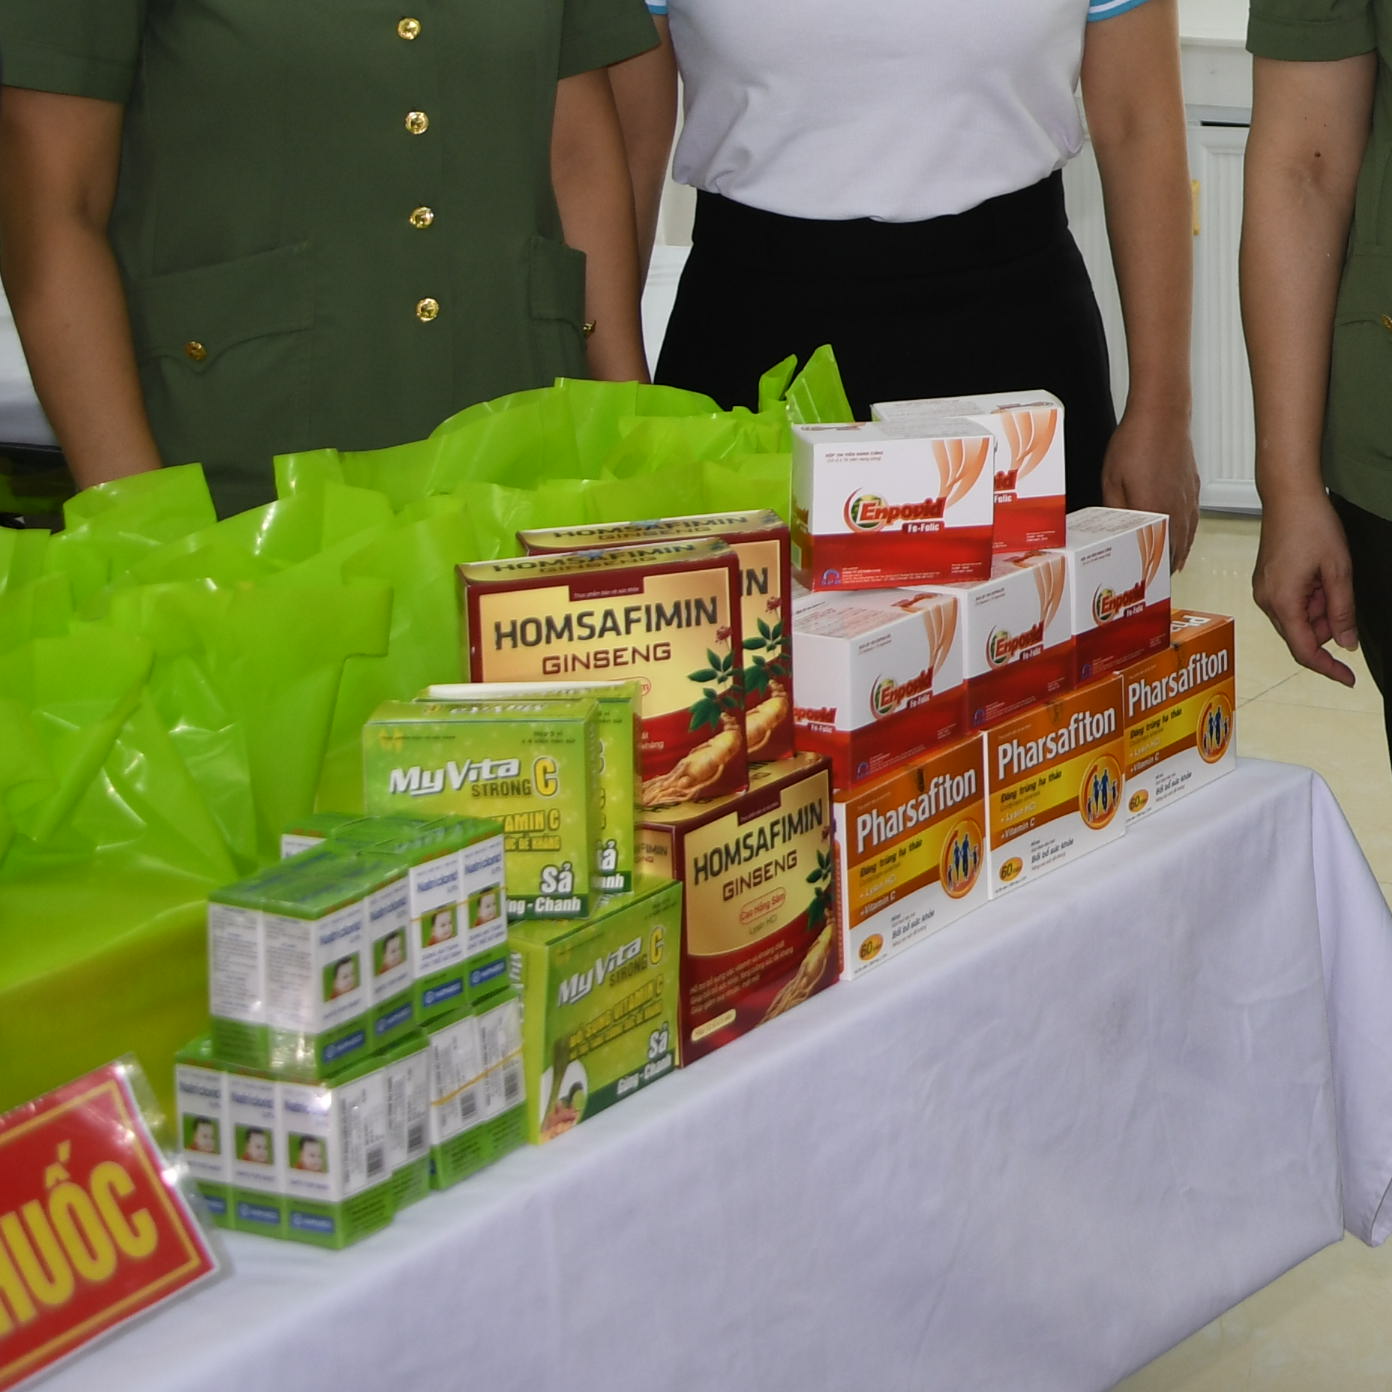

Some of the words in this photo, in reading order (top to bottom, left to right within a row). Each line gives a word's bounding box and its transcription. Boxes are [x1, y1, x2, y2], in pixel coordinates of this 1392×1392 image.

[857, 496, 948, 526] Enpovid
[907, 521, 941, 533] Fe-Folic
[1101, 580, 1145, 615] Enpovid
[494, 596, 718, 650] HOMSAFIMIN
[994, 621, 1044, 658] Enpovid
[542, 642, 672, 676] GINSENG
[880, 666, 934, 707] Enpovid
[1128, 649, 1228, 718] Pharsafiton
[998, 708, 1116, 781] Pharsafiton
[388, 758, 521, 796] MyVita
[471, 779, 532, 799] STRONG
[533, 756, 560, 798] C
[548, 808, 561, 831] C
[857, 768, 976, 854] Pharsafiton
[599, 839, 619, 873] ả
[694, 798, 823, 885] HOMSAFIMIN
[540, 860, 574, 895] Sả
[722, 849, 798, 901] GINSENG
[535, 896, 582, 913] Chanh
[558, 937, 642, 1007] MyVita
[609, 953, 648, 988] STRONG
[649, 926, 664, 968] C
[648, 1020, 669, 1059] Sả
[644, 1053, 672, 1080] Chanh
[0, 1140, 158, 1336] HUỐC
